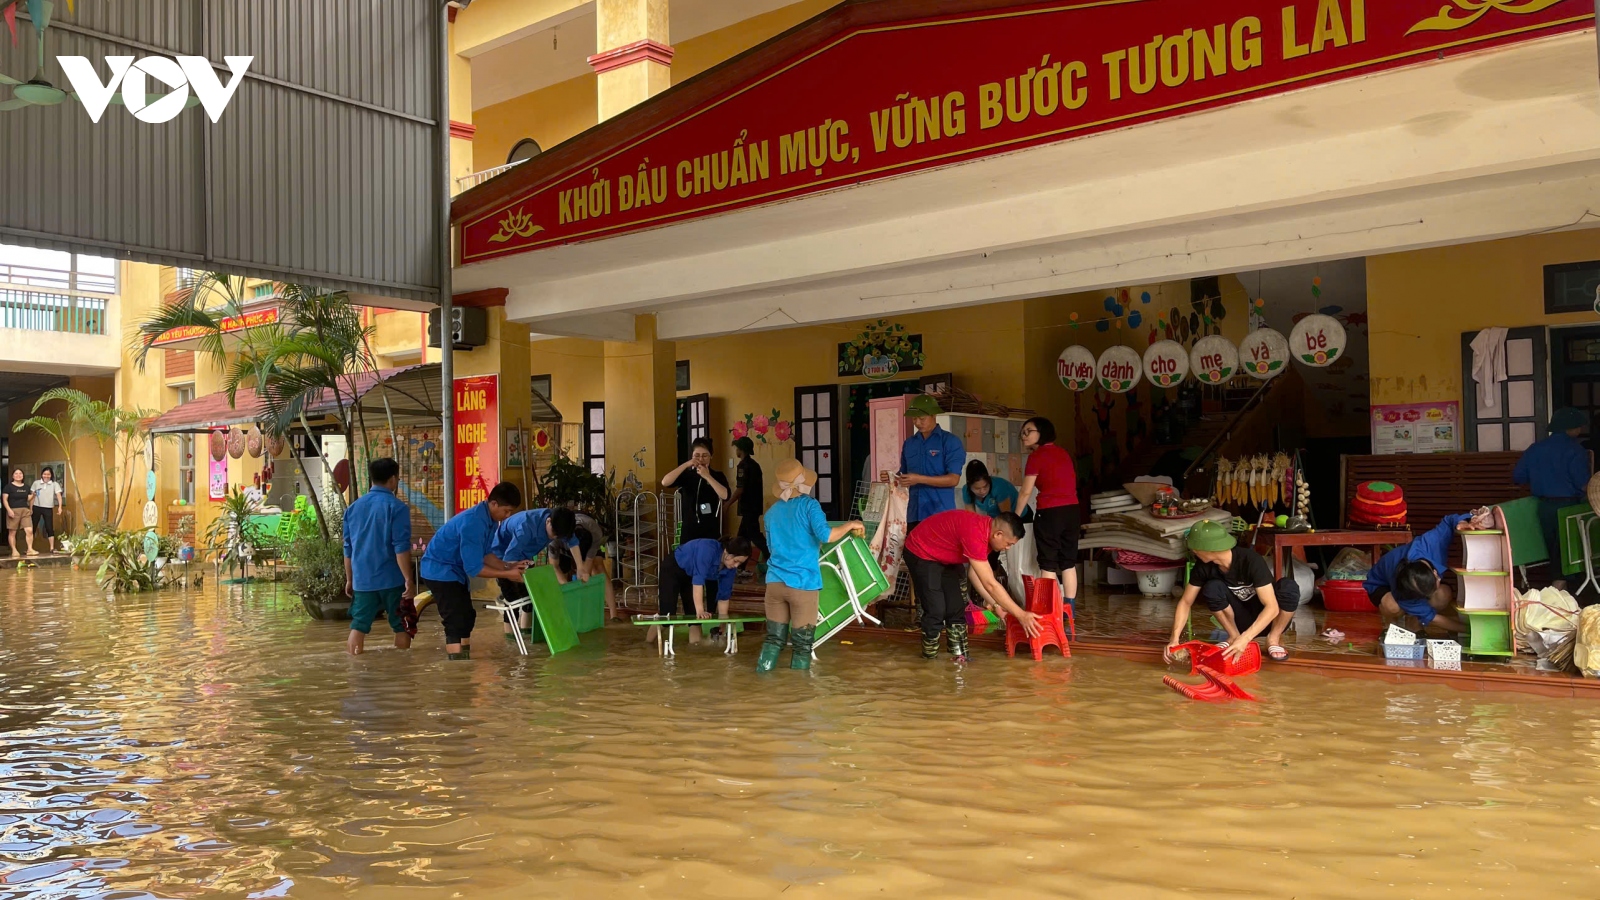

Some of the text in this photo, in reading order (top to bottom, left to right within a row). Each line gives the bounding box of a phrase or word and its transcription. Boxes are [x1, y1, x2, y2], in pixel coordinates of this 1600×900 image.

[558, 0, 1366, 225] KHỞI ĐẦU CHUẨN MỰC, VỮNG BƯỚC TƯƠNG LAI
[1251, 341, 1270, 361] và
[1305, 330, 1327, 351] bé
[1058, 358, 1093, 381] Thư viện
[1101, 360, 1134, 379] dành
[1151, 355, 1177, 374] cho
[1200, 353, 1223, 370] mẹ
[457, 383, 486, 412] LẮNG
[457, 423, 487, 444] NGHE
[465, 446, 480, 477] ĐỂ
[459, 480, 487, 509] HIỂU
